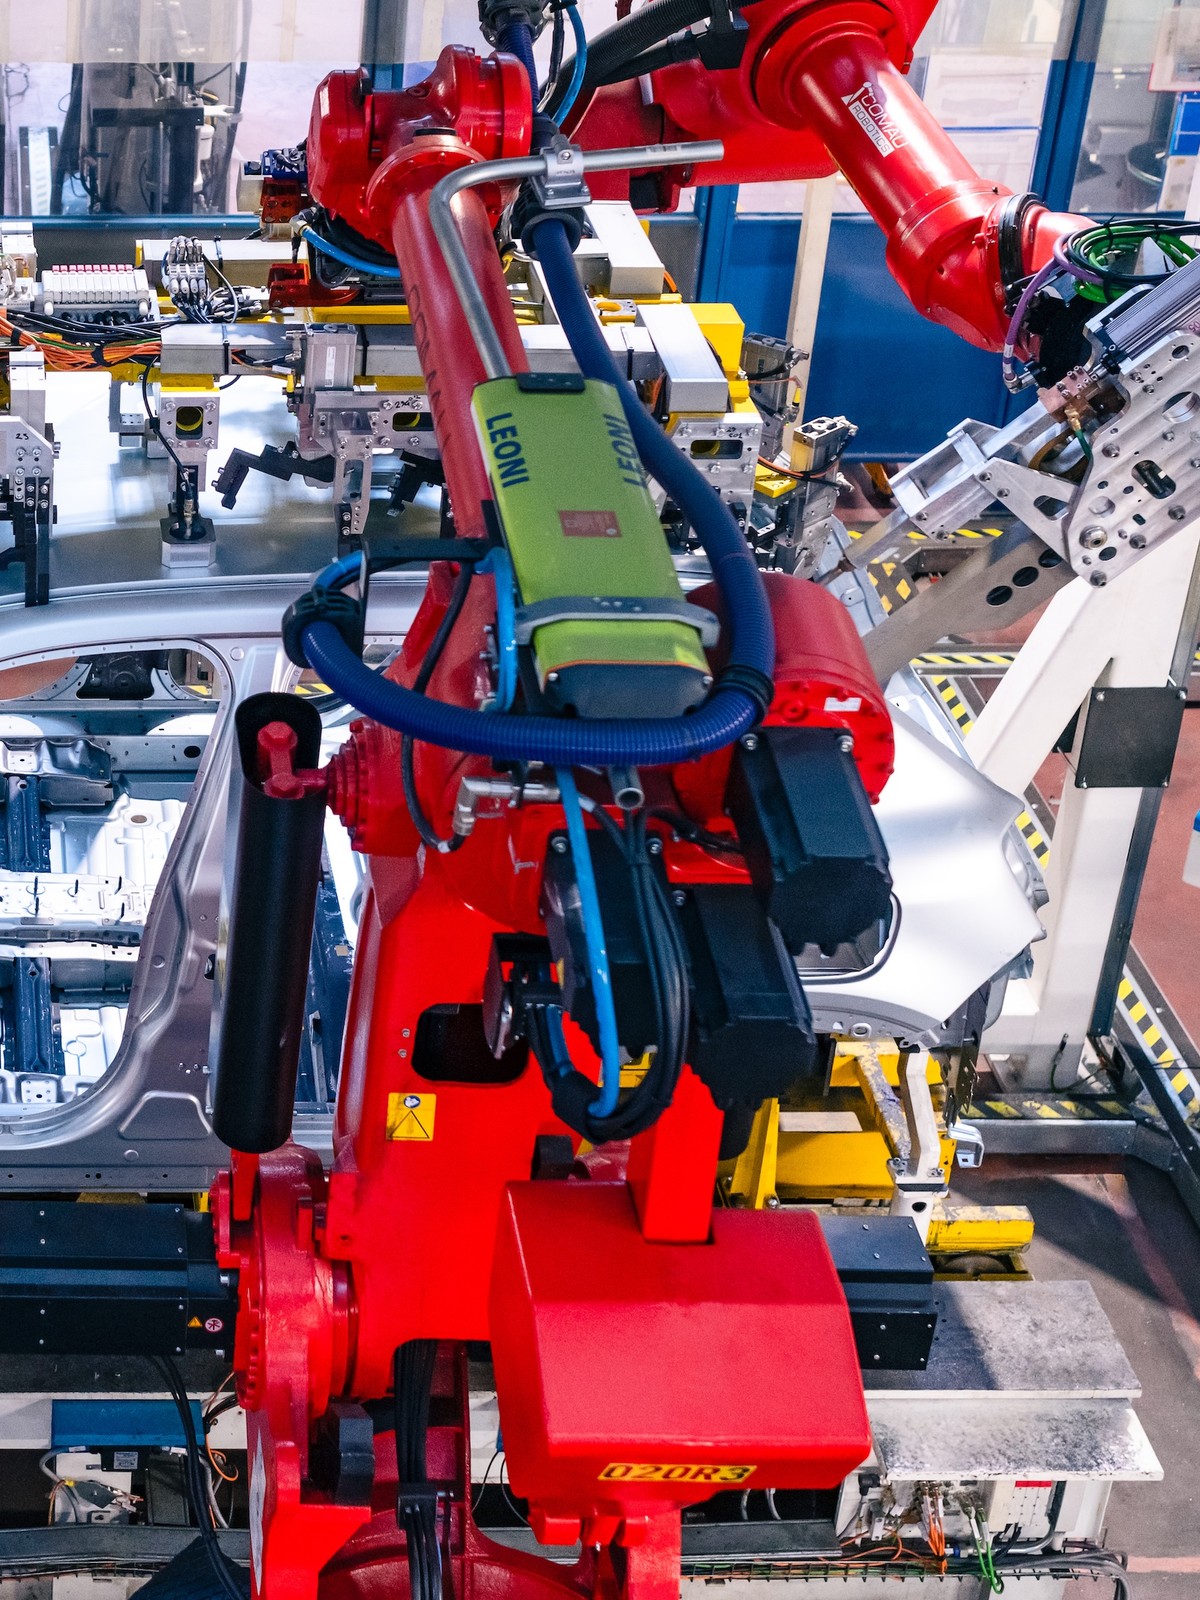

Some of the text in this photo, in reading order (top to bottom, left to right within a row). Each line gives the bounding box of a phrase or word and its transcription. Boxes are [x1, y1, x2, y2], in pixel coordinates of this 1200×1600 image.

[852, 104, 891, 153] ROBOTICS
[861, 94, 910, 149] COMAU
[486, 412, 530, 489] LEONI
[603, 413, 648, 489] LEONI
[604, 1464, 752, 1482] 020R3
